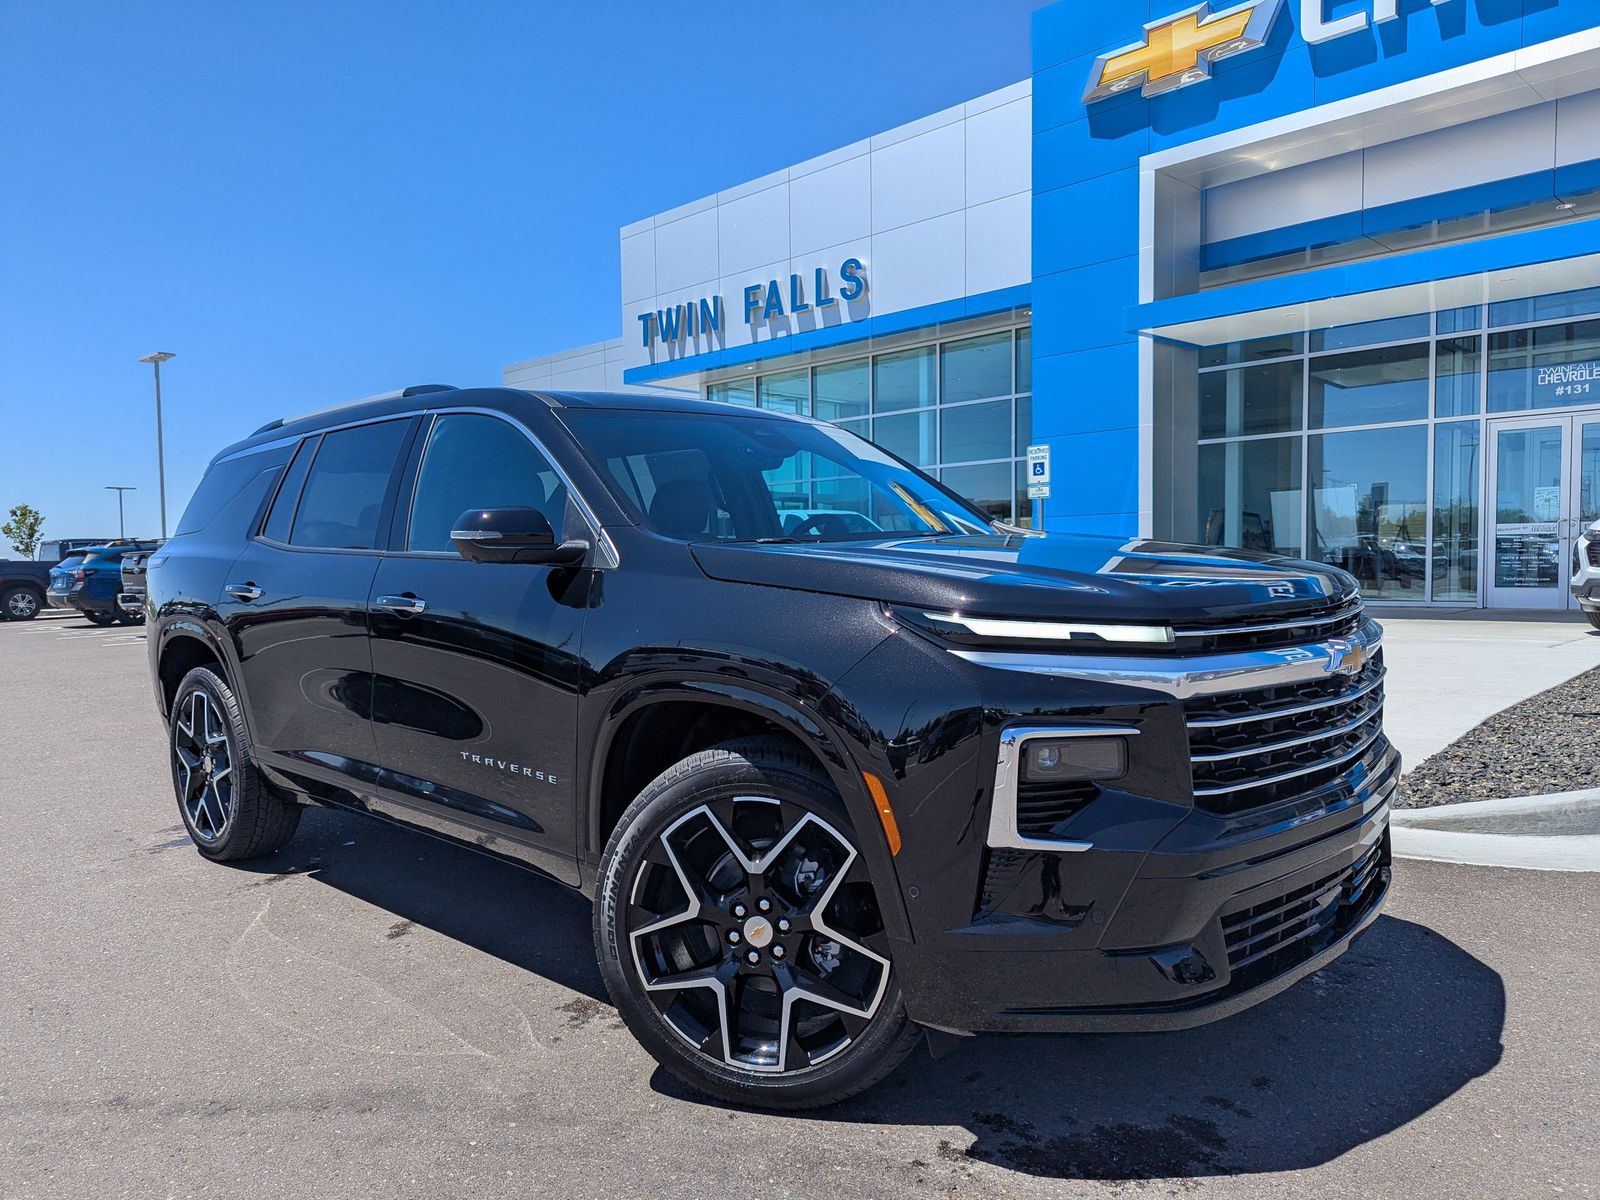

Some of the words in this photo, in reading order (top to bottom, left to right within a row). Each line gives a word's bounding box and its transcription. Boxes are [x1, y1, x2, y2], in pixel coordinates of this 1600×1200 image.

[638, 295, 723, 347] TWIN
[744, 257, 868, 325] FALLS
[1555, 383, 1590, 396] #131
[460, 751, 558, 785] TRAVERSE
[606, 825, 646, 961] CONTINENTAL
